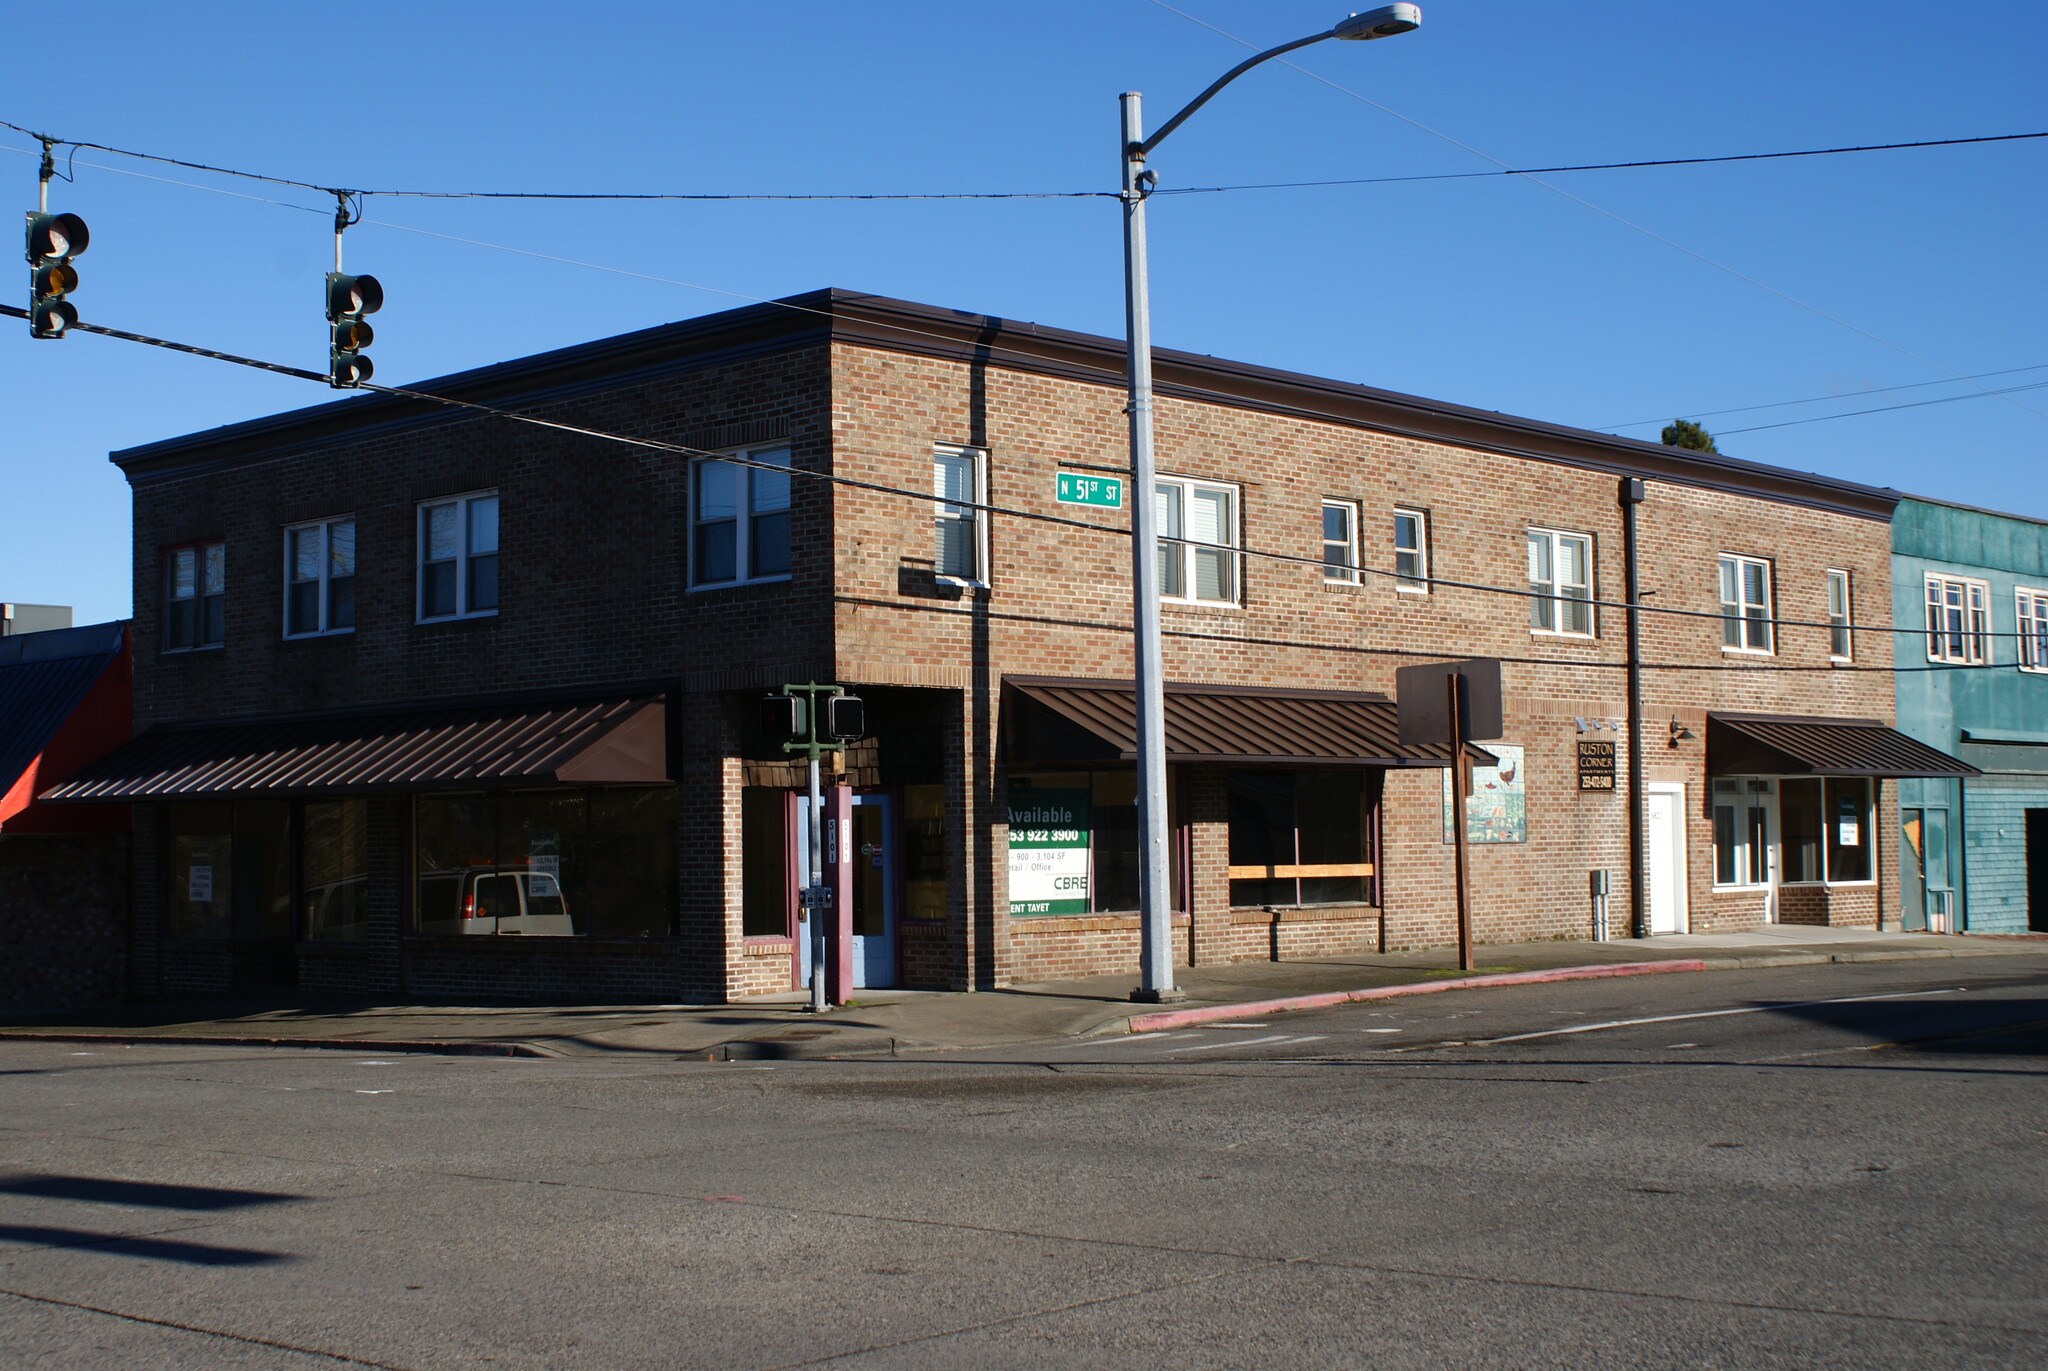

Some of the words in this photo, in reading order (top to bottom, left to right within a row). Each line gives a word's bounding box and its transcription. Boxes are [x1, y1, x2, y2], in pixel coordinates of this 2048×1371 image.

[1061, 480, 1068, 495] N
[1105, 485, 1117, 500] ST
[1580, 743, 1613, 755] RUSTON
[1580, 757, 1613, 767] CORNER
[1008, 829, 1024, 841] 53
[1027, 829, 1048, 841] 922
[1051, 829, 1078, 842] 3900
[1016, 852, 1029, 861] 900
[1036, 852, 1055, 861] 3,104
[1057, 851, 1066, 860] SF
[1031, 862, 1052, 871] Office
[1054, 877, 1088, 890] CBRE
[1027, 903, 1050, 913] TAYET
